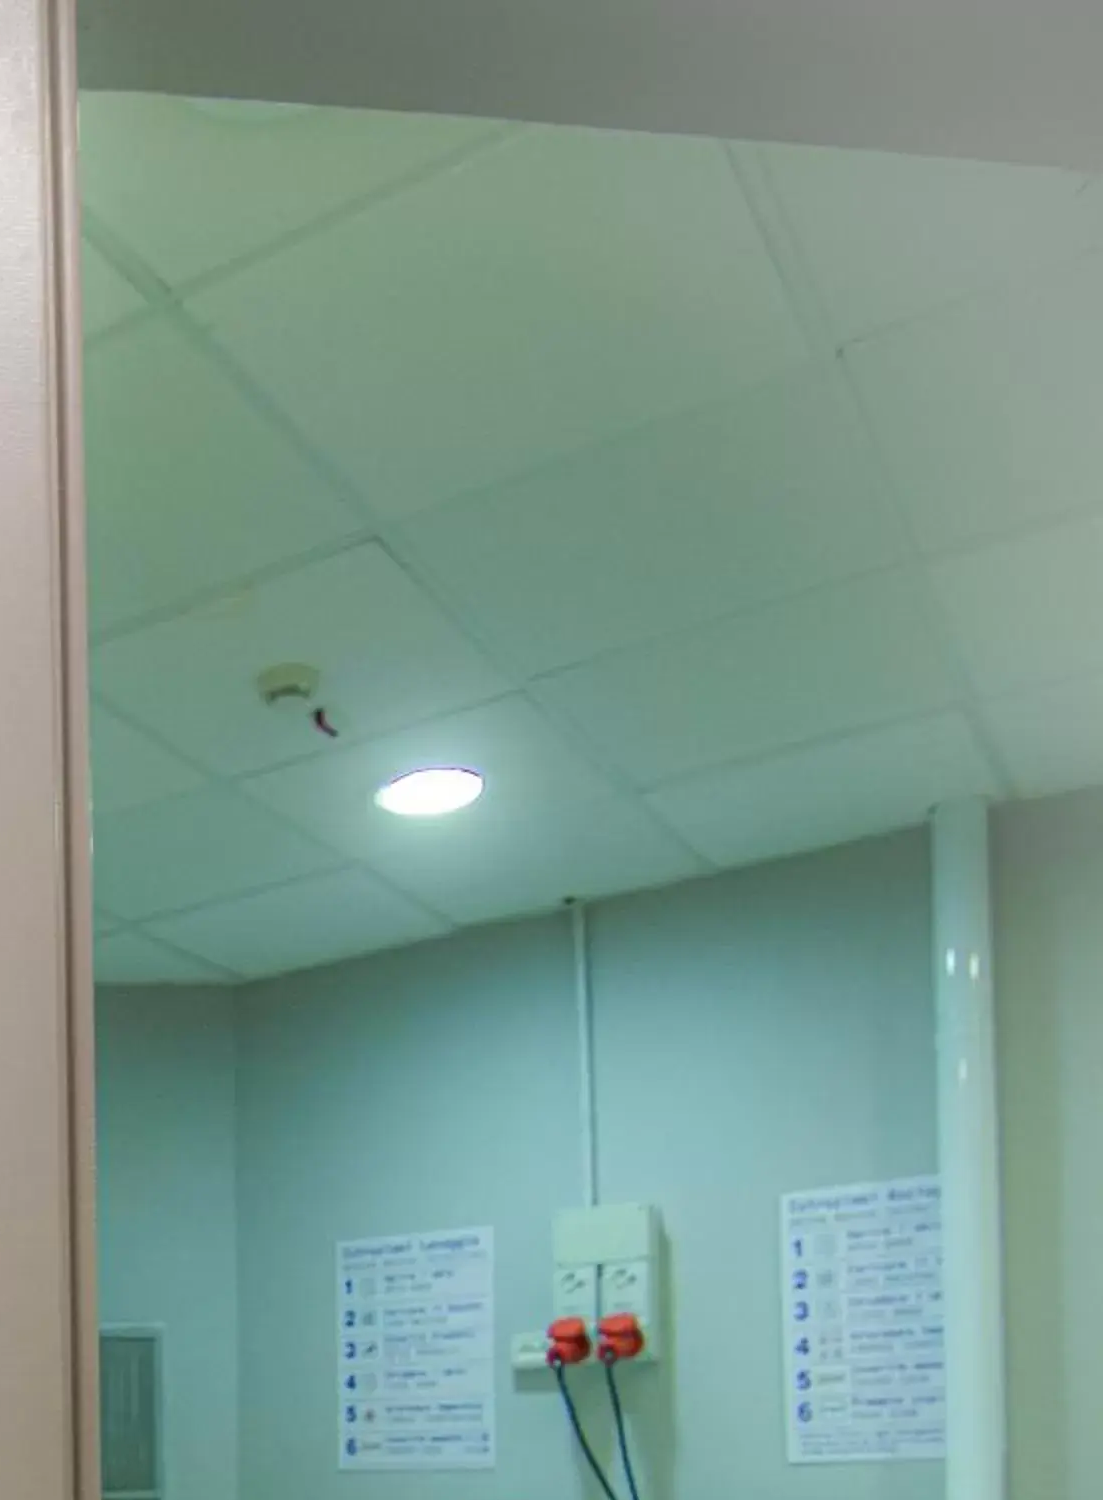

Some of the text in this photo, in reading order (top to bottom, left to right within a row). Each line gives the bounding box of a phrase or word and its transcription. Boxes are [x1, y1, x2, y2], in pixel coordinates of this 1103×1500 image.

[792, 1239, 803, 1258] 1
[344, 1279, 353, 1294] 1
[792, 1269, 809, 1290] 2
[793, 1300, 810, 1321] 3
[794, 1336, 811, 1356] 4
[344, 1373, 357, 1391] 4
[796, 1369, 813, 1391] 5
[797, 1401, 814, 1424] 6
